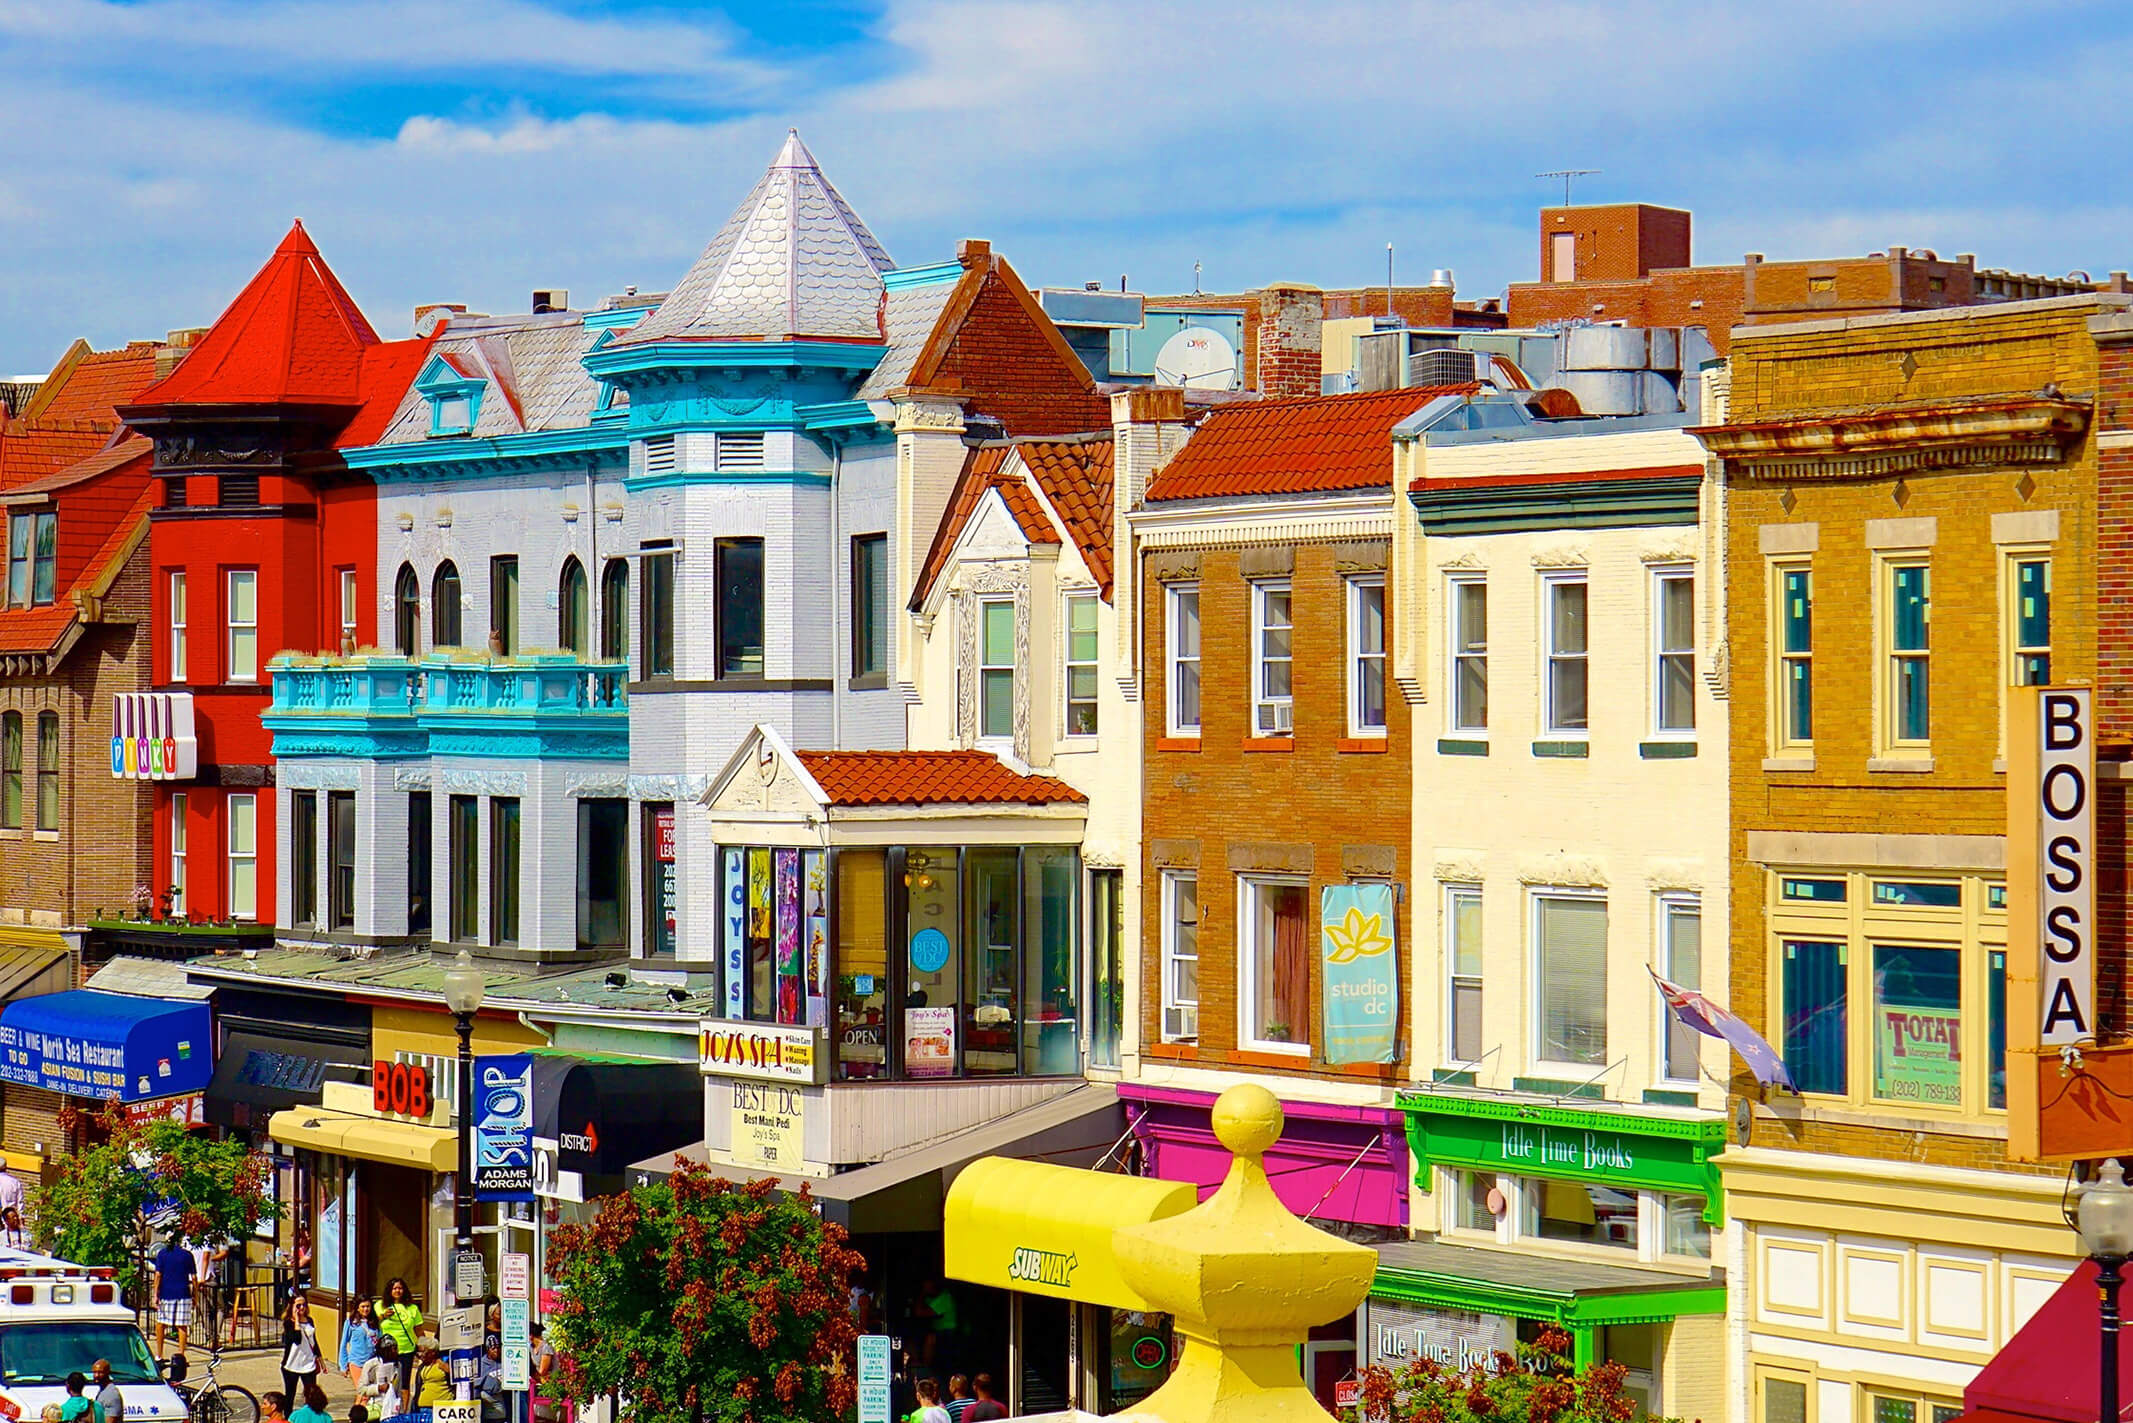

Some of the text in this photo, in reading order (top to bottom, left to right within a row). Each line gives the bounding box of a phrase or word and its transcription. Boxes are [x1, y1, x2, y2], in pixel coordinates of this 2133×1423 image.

[114, 745, 174, 769] PINKY
[2043, 694, 2087, 1034] BOSSA
[1332, 978, 1388, 997] studio
[1364, 997, 1386, 1014] dc
[0, 1026, 16, 1045] BEER
[25, 1032, 40, 1051] WINE
[845, 1030, 878, 1045] OPEN
[8, 1049, 28, 1066] TO GO
[42, 1034, 124, 1069] North Sea Restaurant
[750, 1033, 783, 1073] SPA
[41, 1061, 125, 1087] ASIAN FUSION & SUSHI BAR
[68, 1083, 93, 1095] DELIVERY
[374, 1059, 427, 1118] BOB
[733, 1082, 769, 1112] BEST
[1892, 1080, 1920, 1099] (202)
[483, 1067, 529, 1165] SHOP
[744, 1113, 758, 1125] Best
[758, 1115, 775, 1127] Mani
[560, 1133, 593, 1152] DISTRICT
[769, 1129, 781, 1143] Spa
[1502, 1123, 1633, 1169] Idle Time Books
[479, 1179, 532, 1190] MORGAN
[484, 1169, 527, 1179] ADAMS
[1009, 1246, 1078, 1287] SUBWAY
[1376, 1324, 1498, 1373] Idle Time Book
